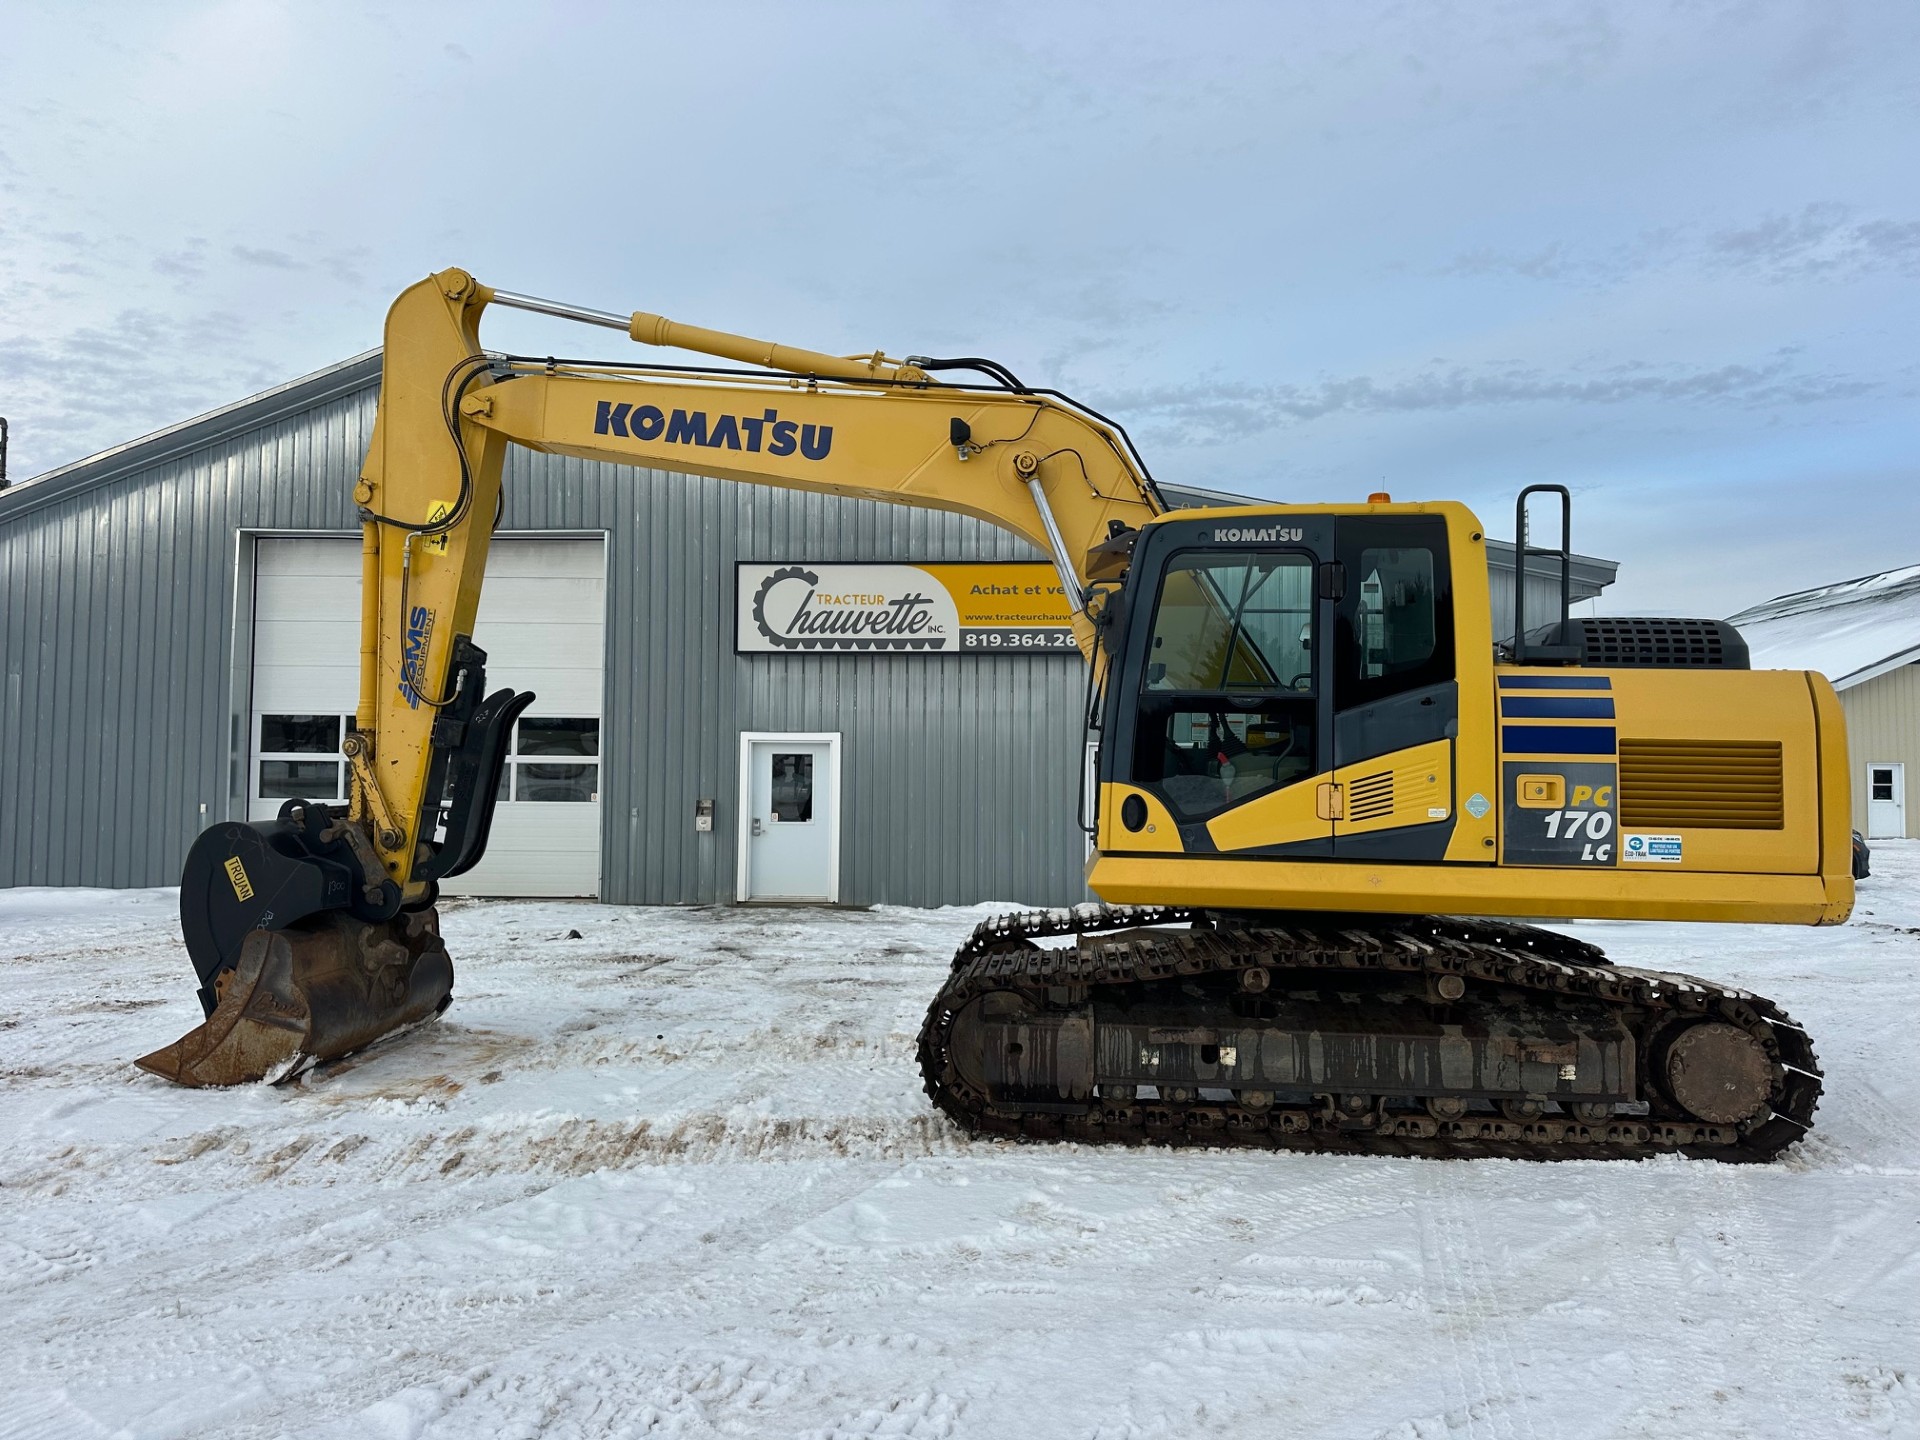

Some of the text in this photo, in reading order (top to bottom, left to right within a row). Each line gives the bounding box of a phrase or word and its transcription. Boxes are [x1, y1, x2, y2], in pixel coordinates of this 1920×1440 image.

[594, 400, 833, 460] KOMATSU
[1214, 524, 1303, 542] KOMATSU
[816, 594, 885, 605] TRACTEUR
[969, 584, 1019, 595] Achat
[1024, 585, 1041, 595] et
[752, 566, 946, 649] Chauvette INC.
[401, 606, 427, 682] SMS
[415, 608, 434, 686] EQUIPMENT
[1570, 785, 1612, 808] PC
[1544, 810, 1612, 840] 170
[1581, 843, 1611, 861] LC
[228, 858, 251, 900] TROJAN
